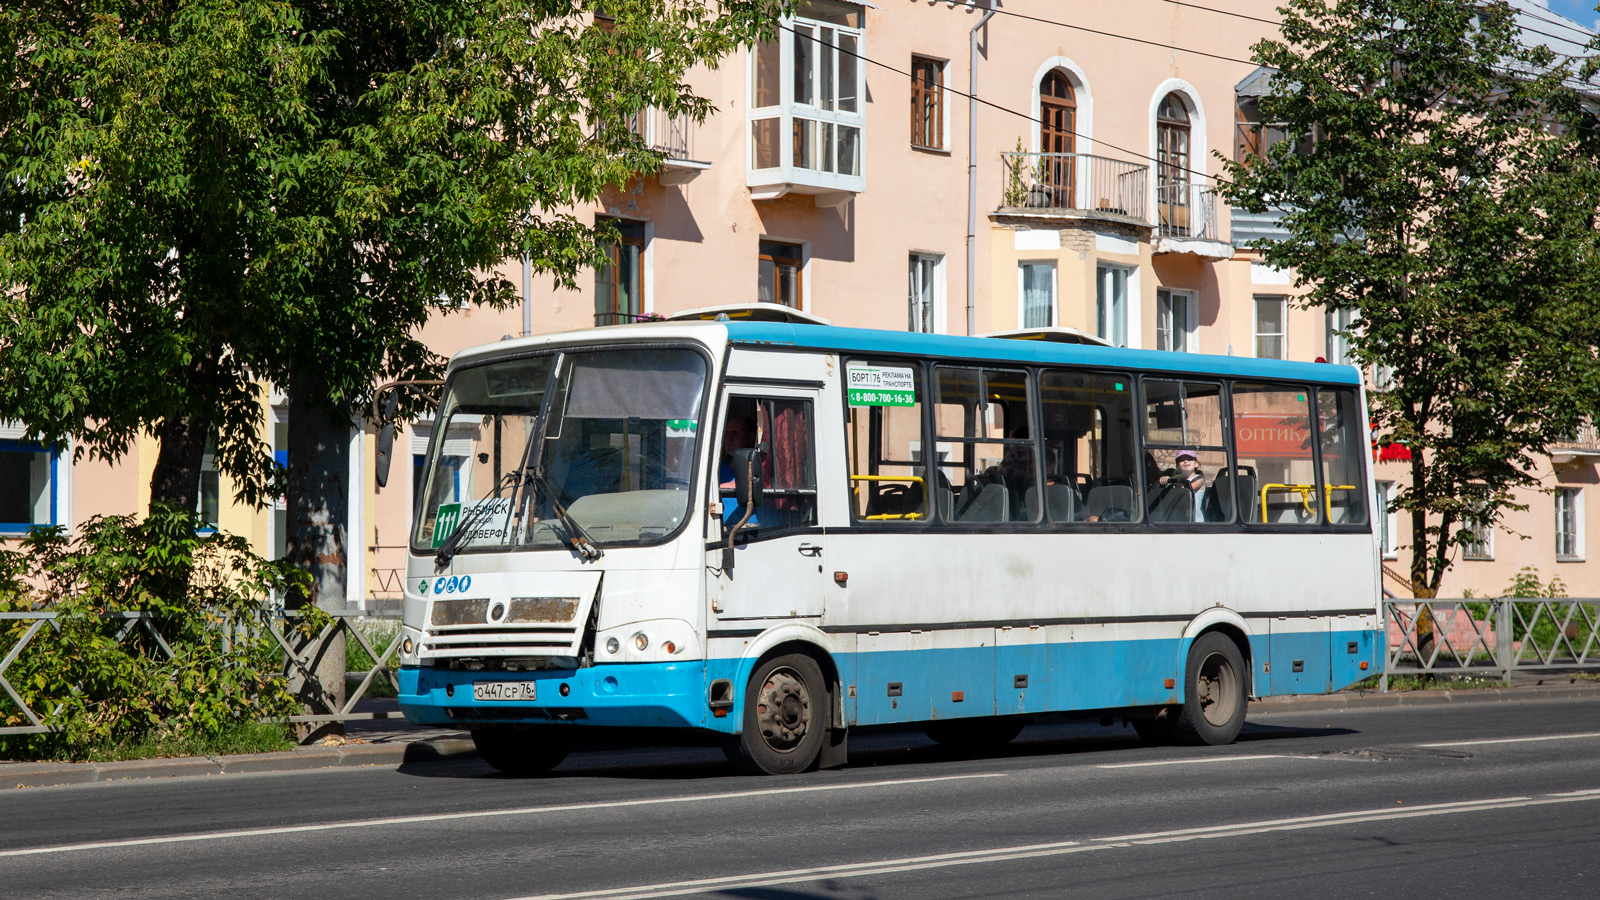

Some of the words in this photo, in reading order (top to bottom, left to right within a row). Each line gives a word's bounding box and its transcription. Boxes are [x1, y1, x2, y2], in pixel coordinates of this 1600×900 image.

[852, 372, 869, 383] БОРТ
[873, 373, 881, 383] 76
[882, 371, 904, 379] РЕКЛАМА
[883, 380, 912, 388] ТРАНСПОРТЕ
[856, 392, 913, 404] 8-800-700-16-36
[437, 511, 457, 541] 111
[520, 683, 531, 694] 76
